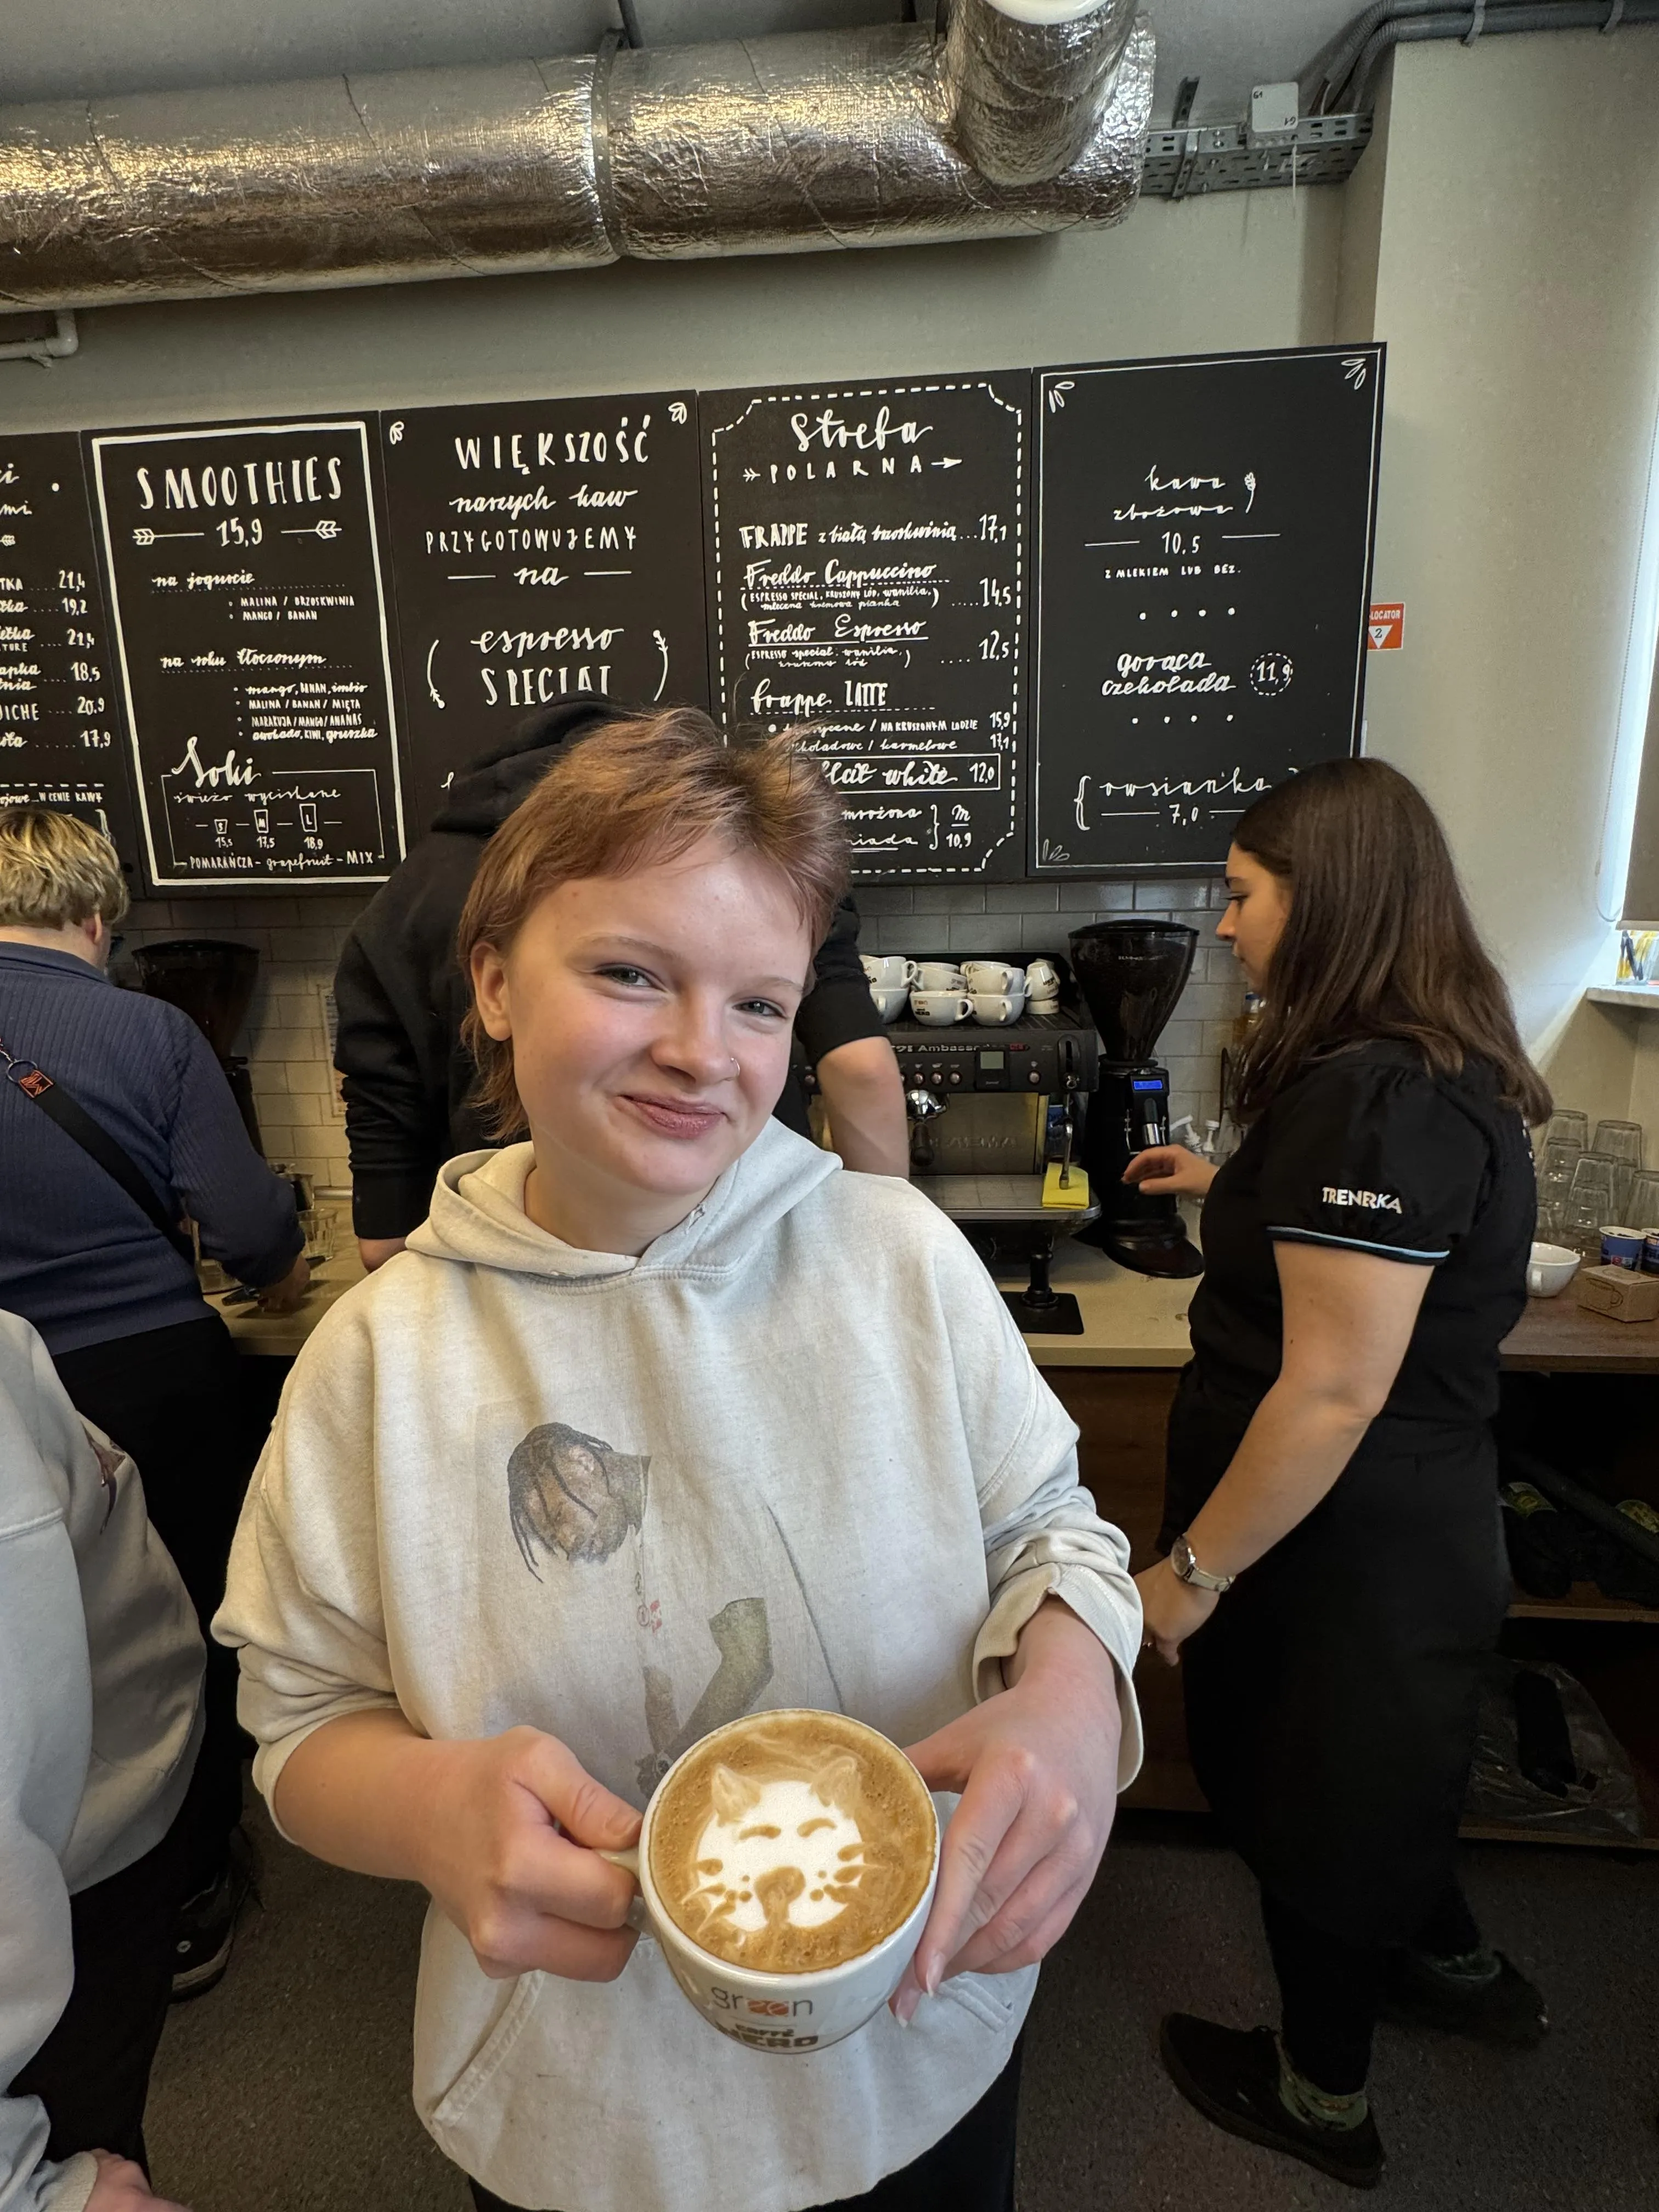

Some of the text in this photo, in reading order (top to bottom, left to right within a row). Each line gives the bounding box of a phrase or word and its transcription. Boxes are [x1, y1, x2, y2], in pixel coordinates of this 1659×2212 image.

[791, 405, 934, 452] Strefa
[455, 414, 651, 475] WIĘKSZOŚĆ
[770, 455, 922, 484] POLARNA
[1144, 464, 1226, 491] kawa
[137, 456, 341, 510] SMOOTHIES
[449, 484, 638, 521] naszych kaw
[1113, 503, 1233, 521] zbożowa
[216, 517, 262, 547] 15,9
[426, 526, 636, 554] PRZYGOTOWUJEMY
[738, 522, 808, 549] FRAPPE
[818, 532, 826, 544] z
[151, 569, 255, 591] na jogurcie
[514, 567, 569, 586] na
[743, 558, 938, 589] Freddo Cappuccino
[1116, 567, 1169, 578] MLEKIEM
[1181, 566, 1201, 575] LUB
[240, 596, 278, 607] MALINA
[294, 595, 354, 607] BRZOSKWINIA
[242, 611, 273, 621] MANGO
[287, 610, 318, 620] BANAN
[747, 613, 927, 645] Freddo Espresso
[1374, 628, 1383, 638] 2
[470, 627, 624, 658] espresso
[160, 657, 184, 669] na
[190, 651, 227, 667] soku
[1102, 670, 1237, 696] czekolada
[249, 699, 281, 709] MALINA
[292, 699, 321, 709] BANAN
[332, 698, 361, 713] MIĘTA
[750, 678, 888, 718] frappe LATTE
[251, 715, 292, 727] MARAKUJA
[330, 713, 362, 726] ANANAS
[880, 721, 894, 732] NA
[879, 738, 958, 752] karmelowe
[171, 736, 262, 788] Soki
[882, 761, 958, 786] white
[347, 850, 373, 864] MIX
[1322, 1187, 1403, 1215] TRENERKA
